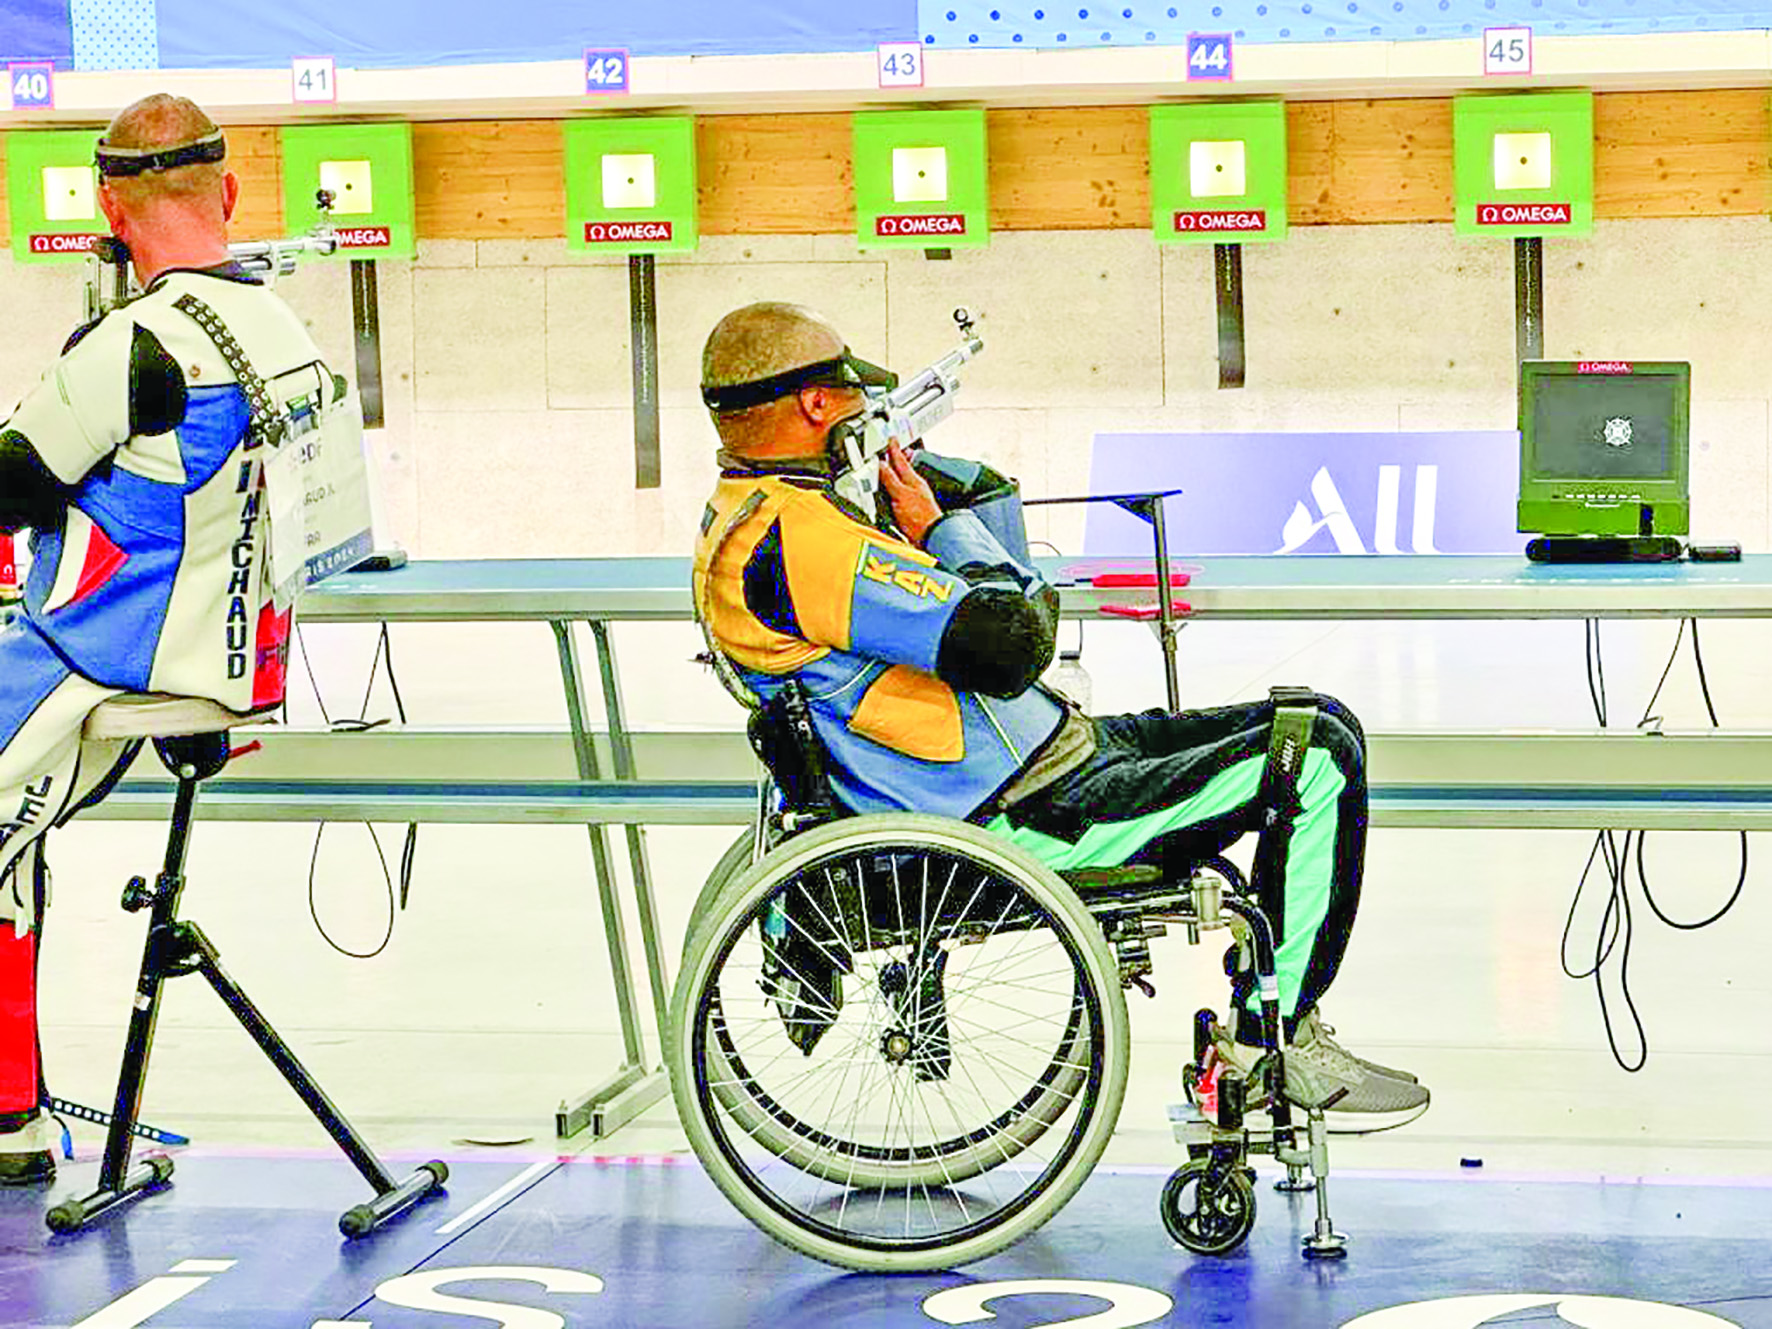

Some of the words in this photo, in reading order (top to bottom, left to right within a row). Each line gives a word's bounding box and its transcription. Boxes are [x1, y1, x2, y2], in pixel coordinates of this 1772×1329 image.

[1189, 43, 1228, 70] 44
[1488, 40, 1525, 62] 45
[587, 58, 624, 84] 42
[883, 54, 916, 76] 43
[14, 73, 48, 99] 40
[298, 69, 328, 92] 41
[1198, 213, 1262, 229] OMEGA
[1501, 206, 1567, 222] OMEGA
[608, 224, 669, 239] OMEGA
[899, 218, 962, 233] OMEGA
[1591, 363, 1628, 372] OMEGA
[863, 556, 955, 603] KAZ
